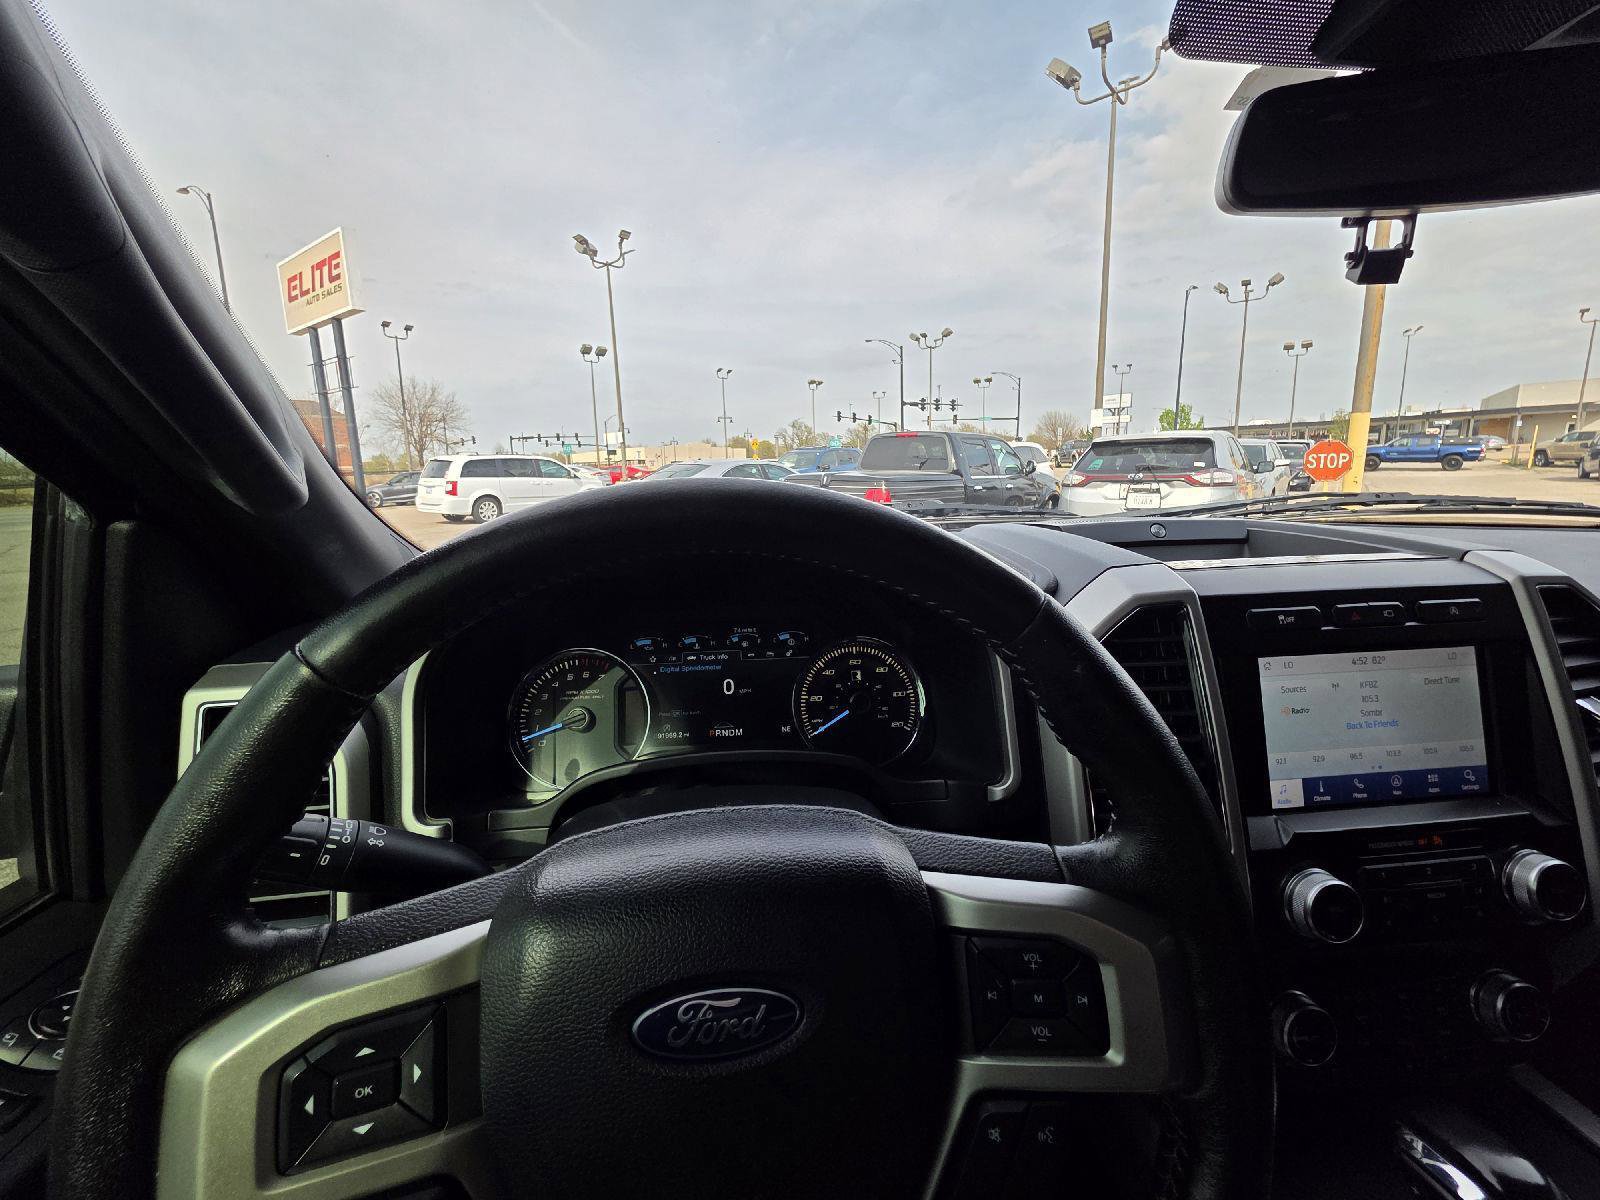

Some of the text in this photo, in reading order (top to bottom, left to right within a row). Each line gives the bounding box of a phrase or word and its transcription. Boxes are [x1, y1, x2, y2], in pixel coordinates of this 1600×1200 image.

[287, 250, 341, 303] ELITE
[306, 282, 343, 306] AUTO SALES
[1307, 452, 1350, 469] STOP
[1351, 656, 1368, 665] 4:52
[659, 664, 722, 673] Digital Speedometer
[1424, 676, 1460, 686] Direct Tune
[723, 678, 735, 695] 0
[1280, 685, 1307, 694] Sources
[1346, 722, 1364, 730] Back
[1373, 719, 1399, 729] Friends
[1022, 952, 1043, 962] VOL
[1033, 993, 1043, 1003] M
[667, 997, 767, 1048] Ford
[1031, 1026, 1052, 1036] VOL
[354, 1084, 373, 1099] OK
